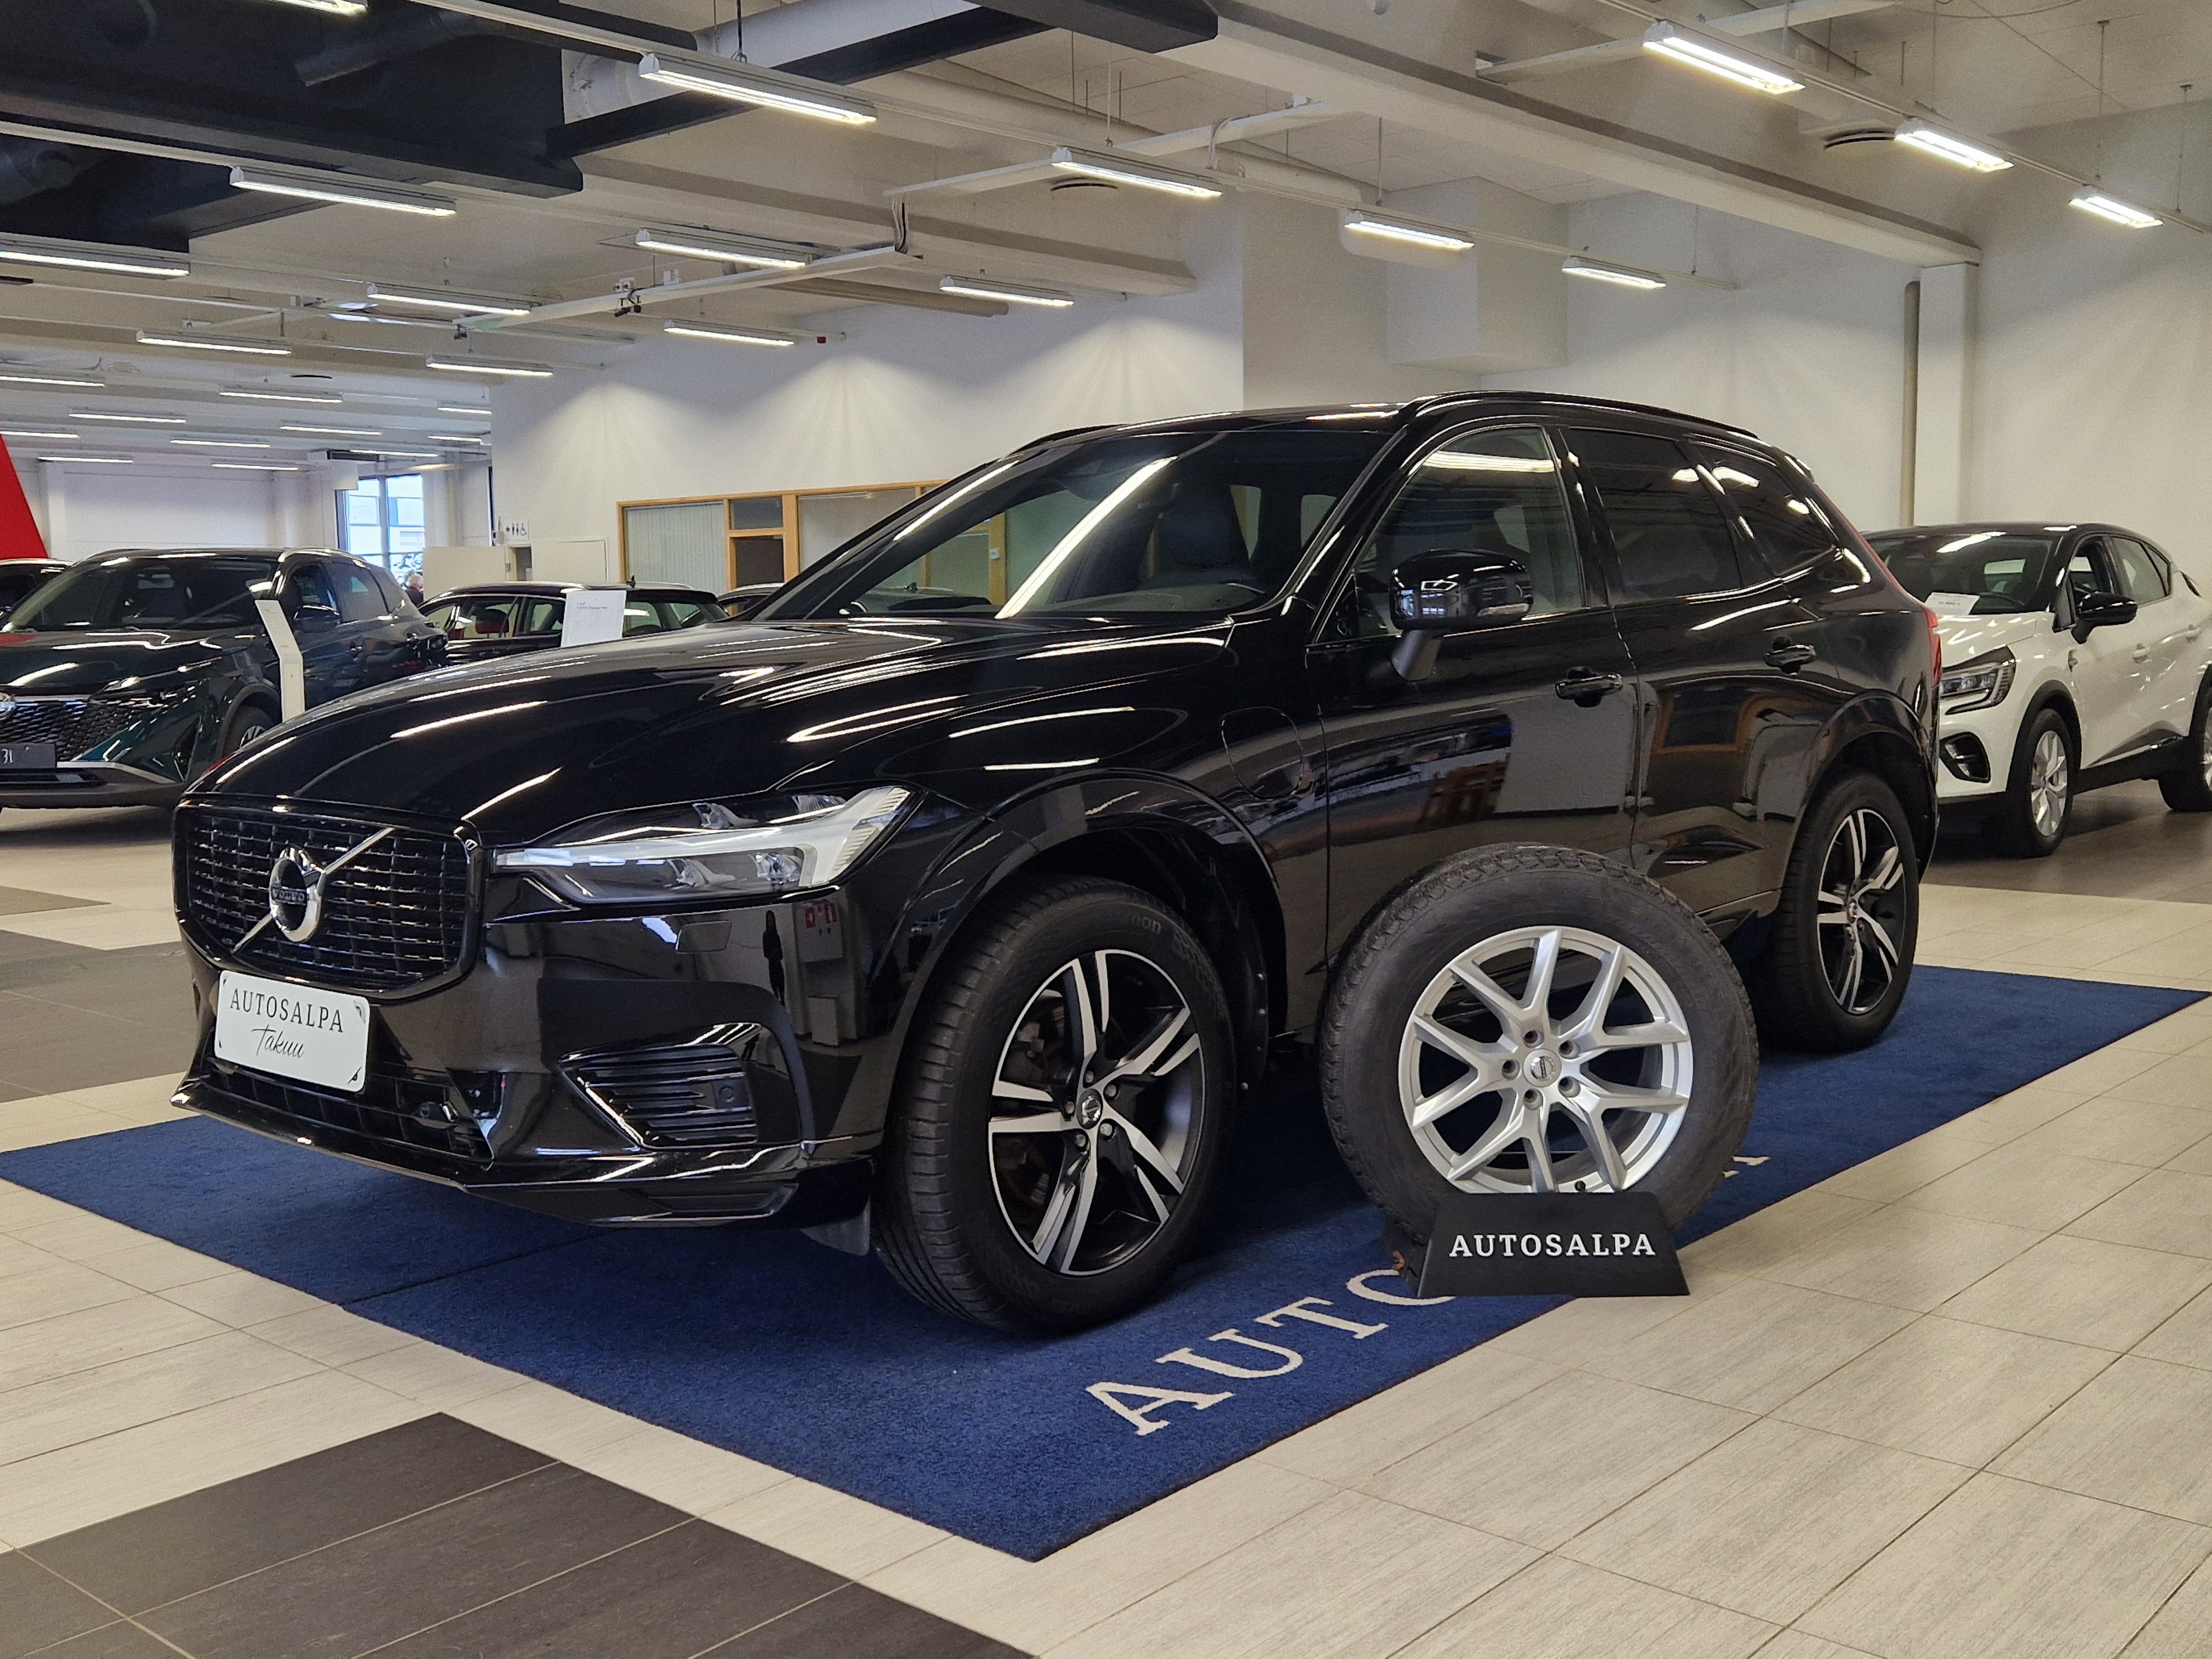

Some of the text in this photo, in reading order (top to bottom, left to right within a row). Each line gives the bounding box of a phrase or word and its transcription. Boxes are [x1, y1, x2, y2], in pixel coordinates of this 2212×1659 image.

[272, 888, 305, 902] VOLVO
[229, 988, 343, 1033] AUTOSALPA
[251, 1024, 304, 1058] Takuu
[1449, 1234, 1656, 1257] AUTOSALPA
